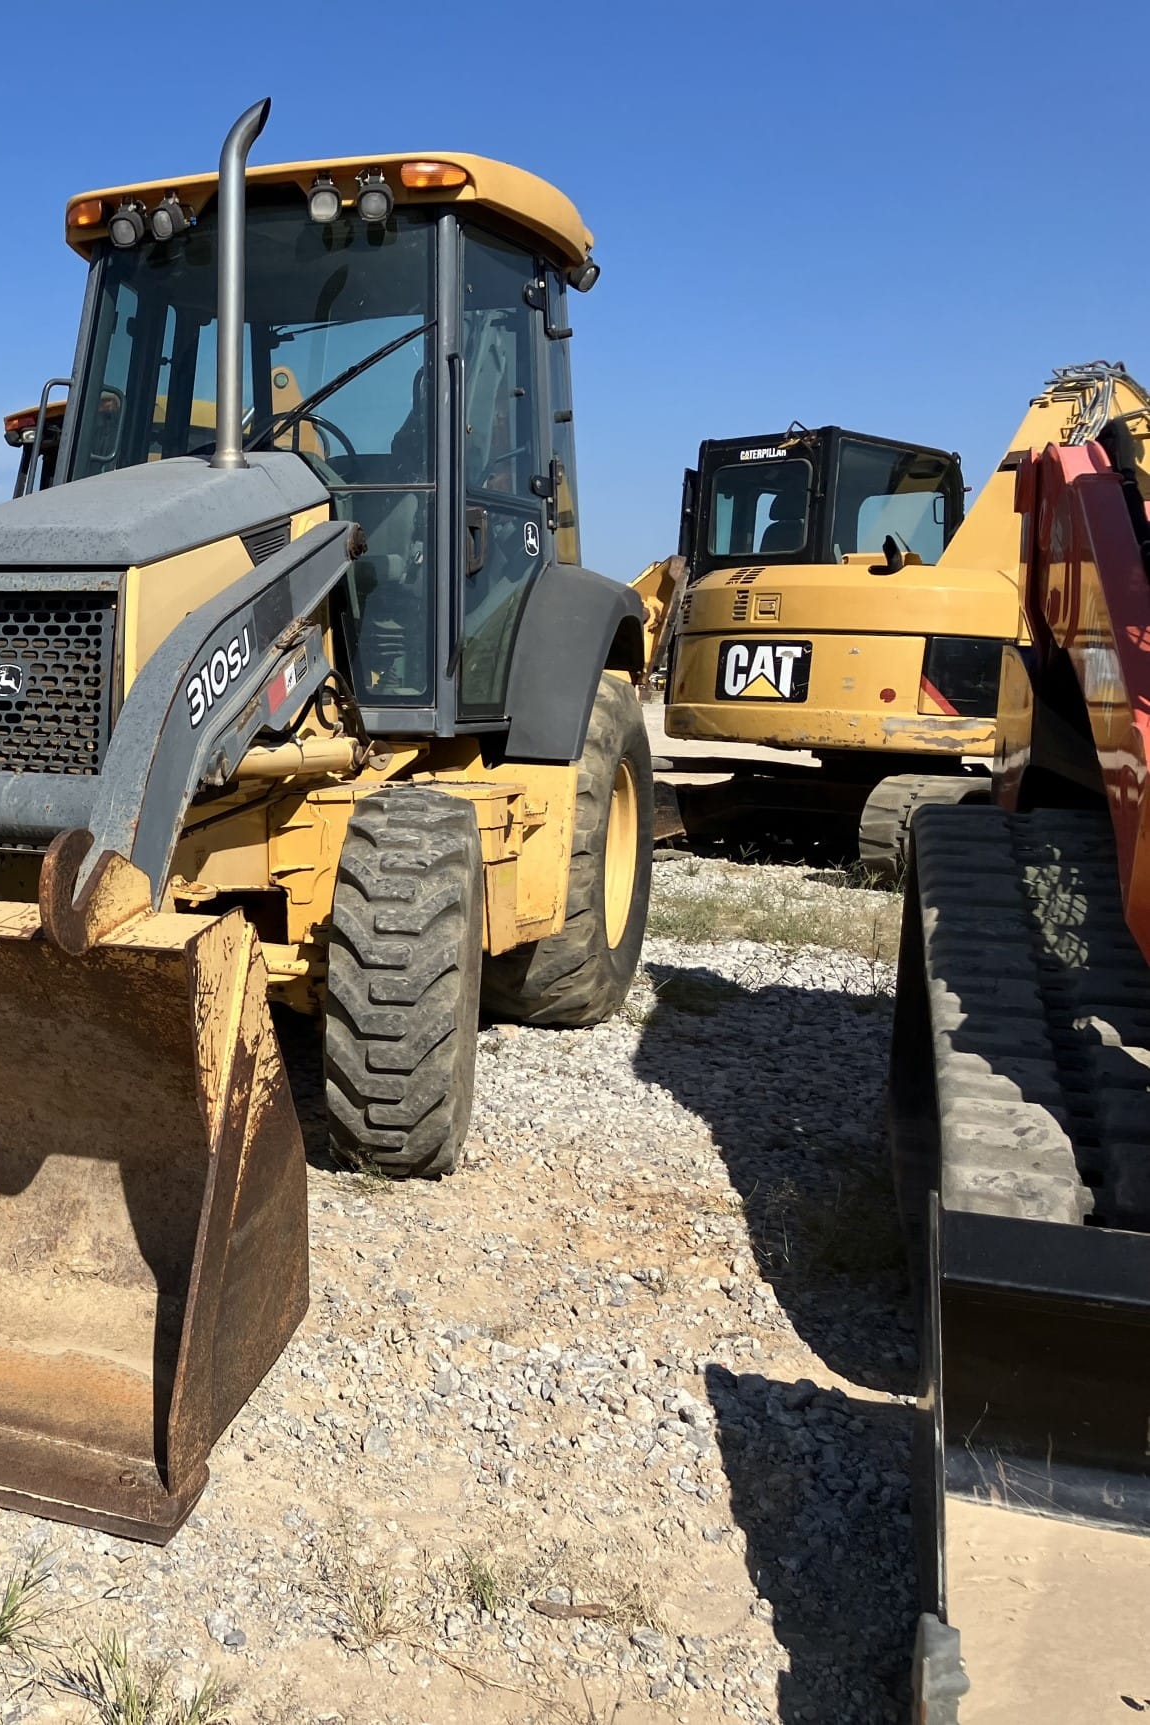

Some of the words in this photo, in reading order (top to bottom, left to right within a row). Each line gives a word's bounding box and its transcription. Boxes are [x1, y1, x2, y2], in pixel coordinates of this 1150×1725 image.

[740, 448, 787, 460] CATERPILLAR
[186, 626, 251, 728] 310SJ
[724, 644, 803, 699] CAT
